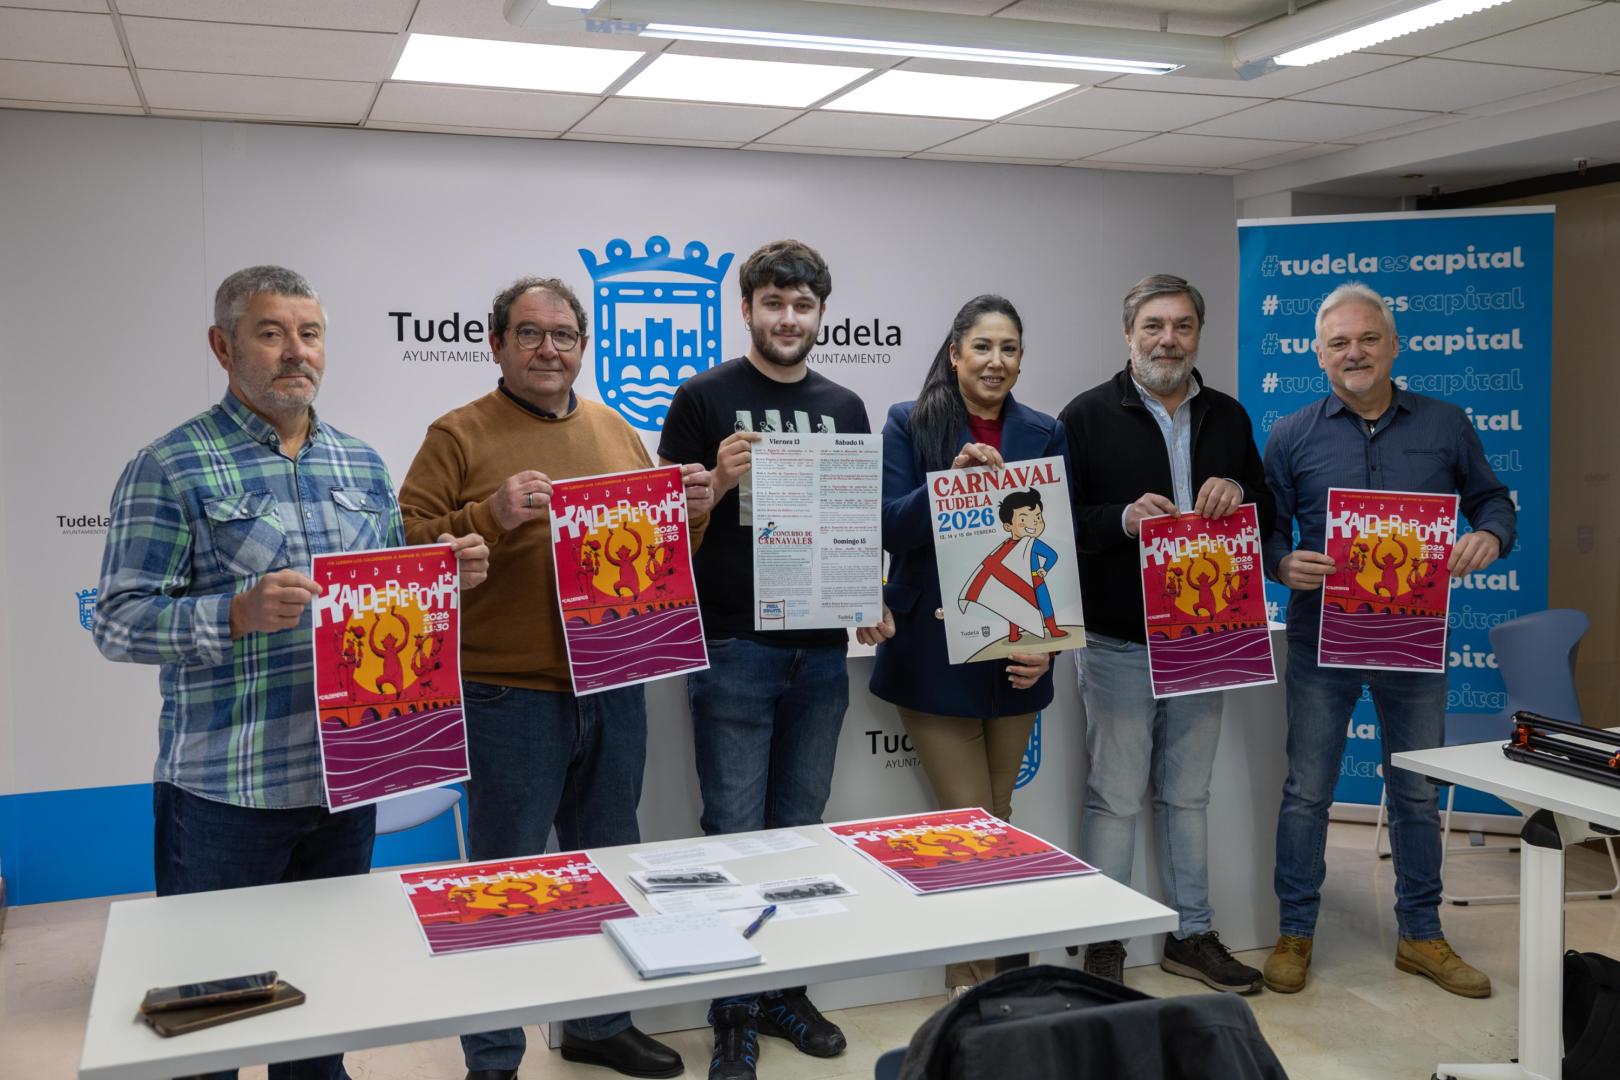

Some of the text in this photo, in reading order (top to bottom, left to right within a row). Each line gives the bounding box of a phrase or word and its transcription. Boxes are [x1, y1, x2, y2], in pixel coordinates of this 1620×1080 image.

[1261, 244, 1525, 277] #tudelaescapital
[815, 318, 902, 347] udela
[933, 463, 1061, 497] CARNAVAL
[562, 480, 672, 503] TUDELA
[936, 494, 993, 513] TUDELA
[1339, 501, 1445, 514] TUDELA
[57, 514, 111, 528] Tudela
[938, 507, 996, 533] 2026
[1150, 516, 1252, 536] TUDELA
[654, 524, 679, 535] 2026
[973, 528, 997, 536] FEBRERO
[833, 538, 859, 546] Domingo
[1420, 544, 1445, 552] 2026
[1230, 555, 1253, 564] 2026
[326, 560, 446, 581] TUDELA
[423, 611, 450, 622] 2026
